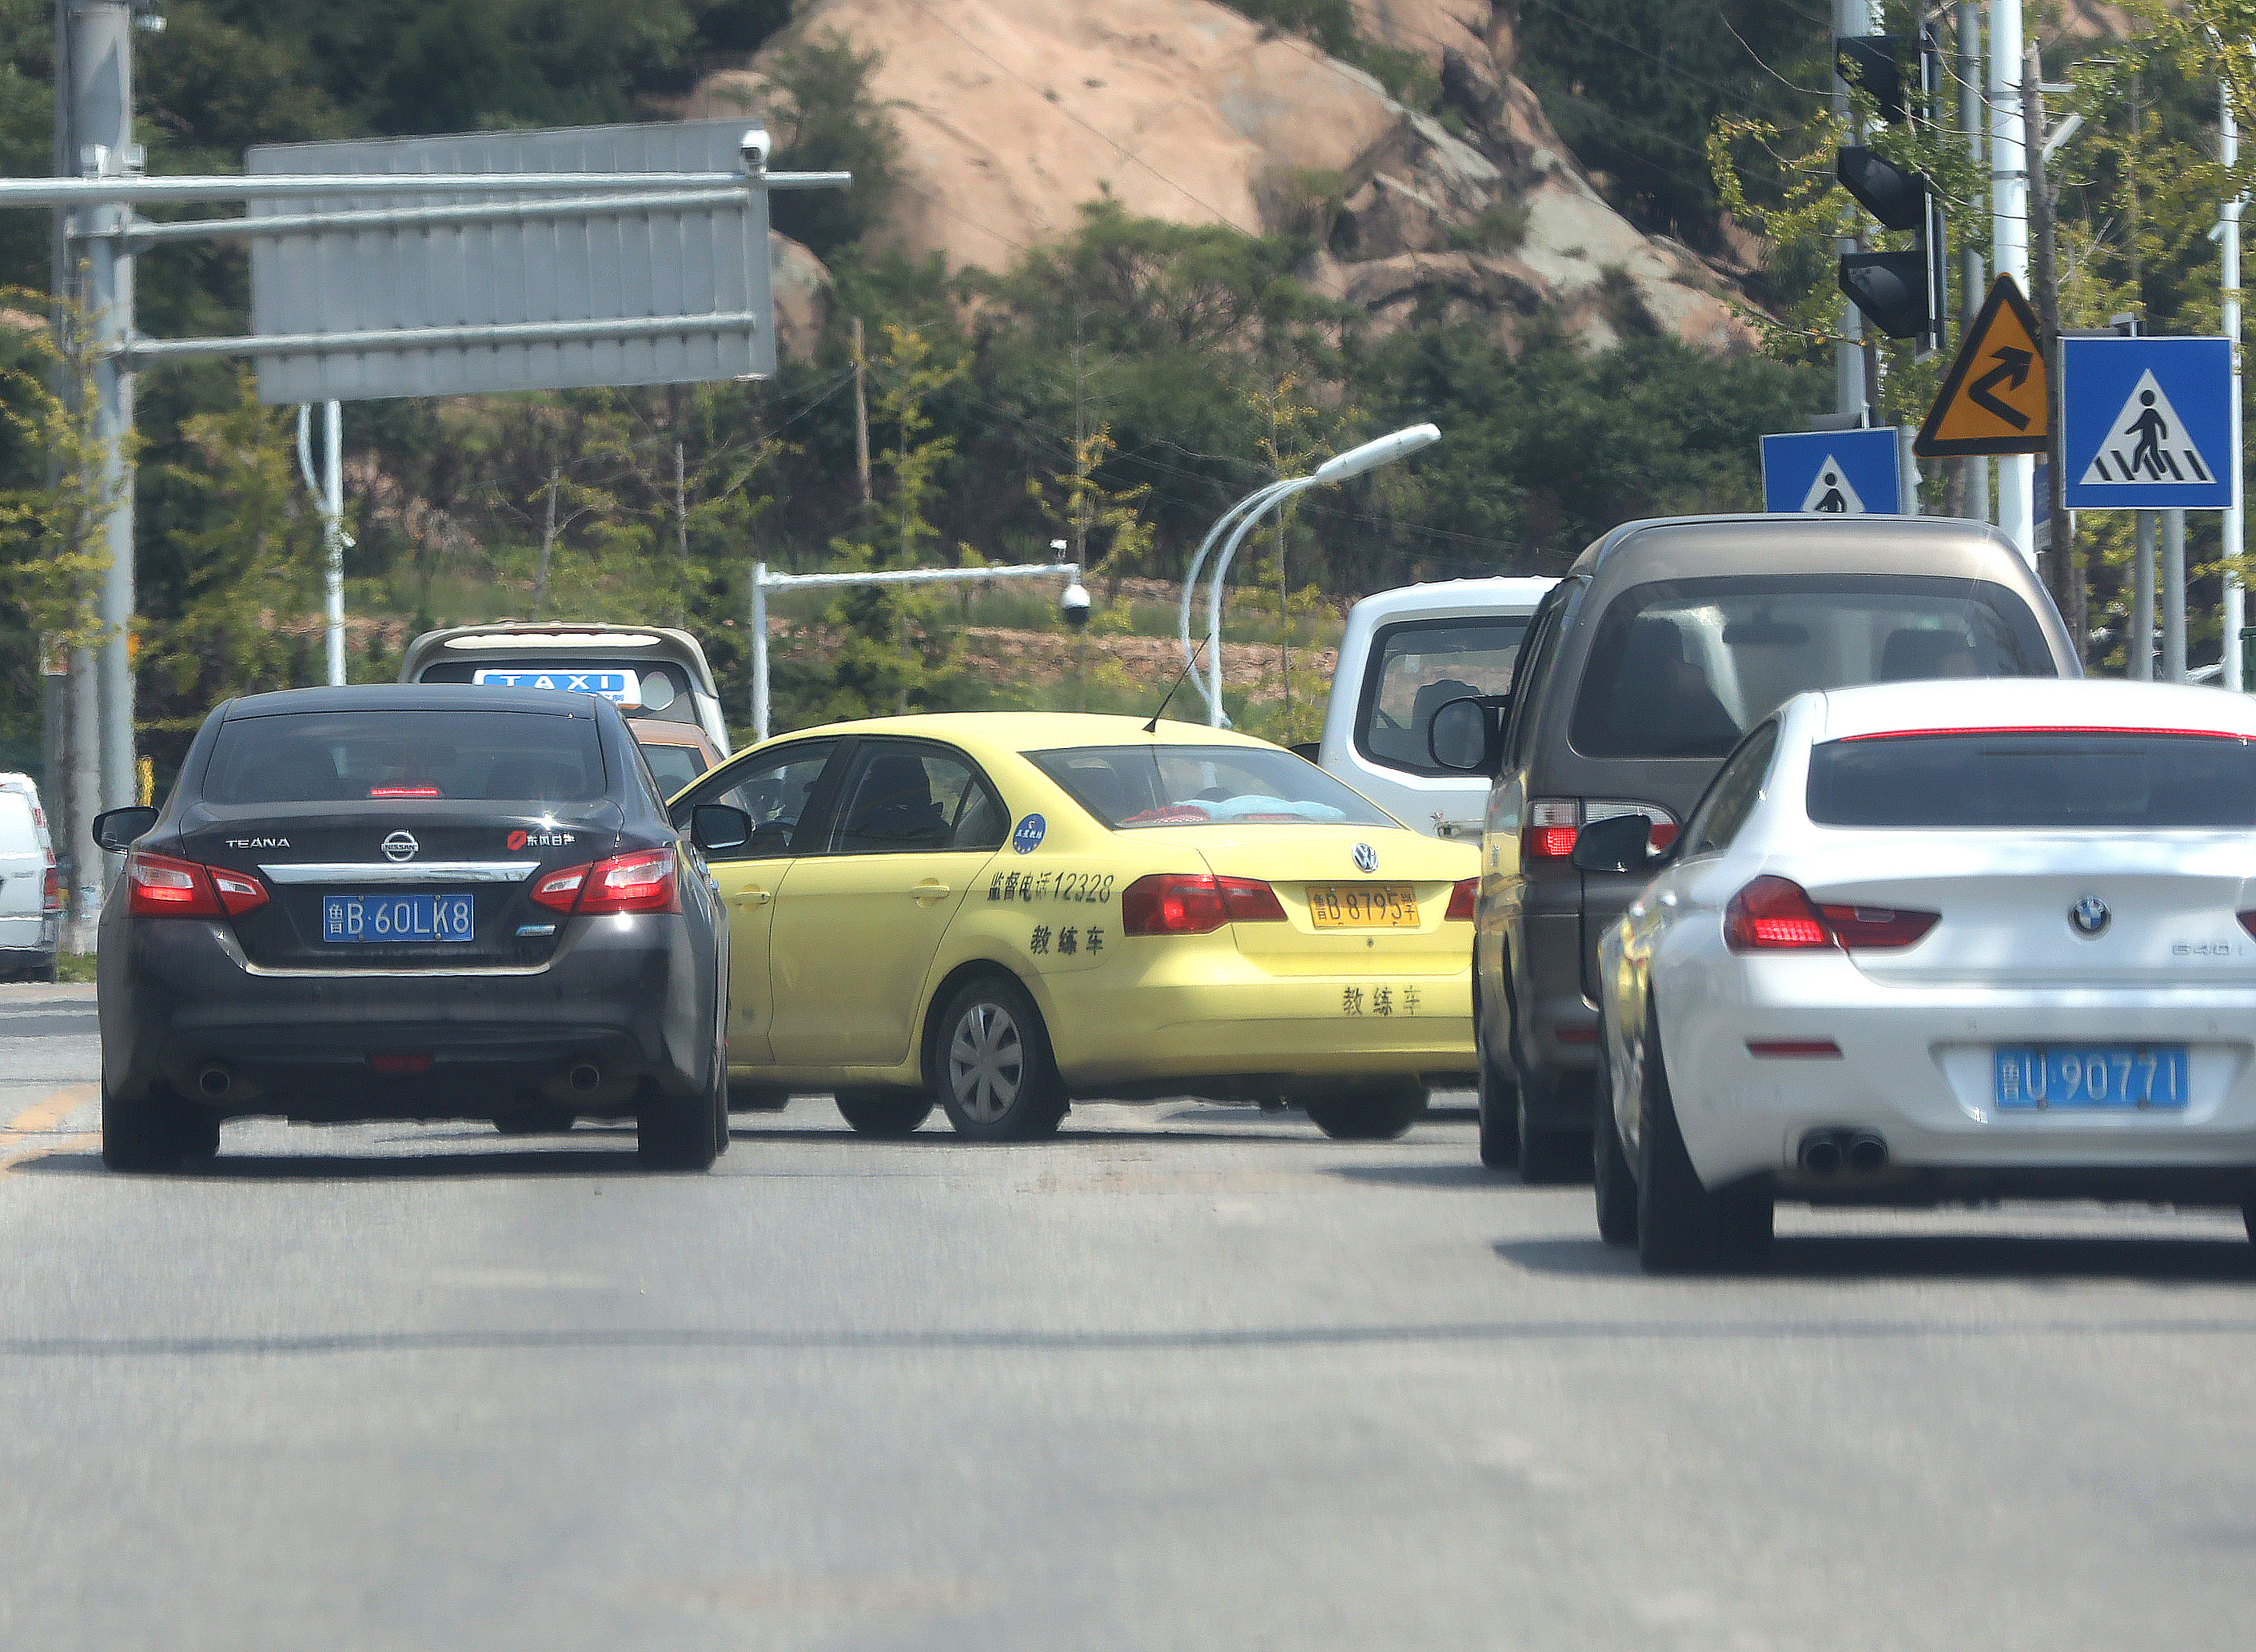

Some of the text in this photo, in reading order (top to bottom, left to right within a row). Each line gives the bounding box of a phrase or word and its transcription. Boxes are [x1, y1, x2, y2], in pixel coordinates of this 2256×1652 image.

[500, 675, 609, 690] TAXI
[225, 837, 291, 849] TEANA
[987, 870, 1114, 904] 监督电话12328
[1030, 925, 1105, 956] 教练车
[1343, 985, 1421, 1016] 教练车
